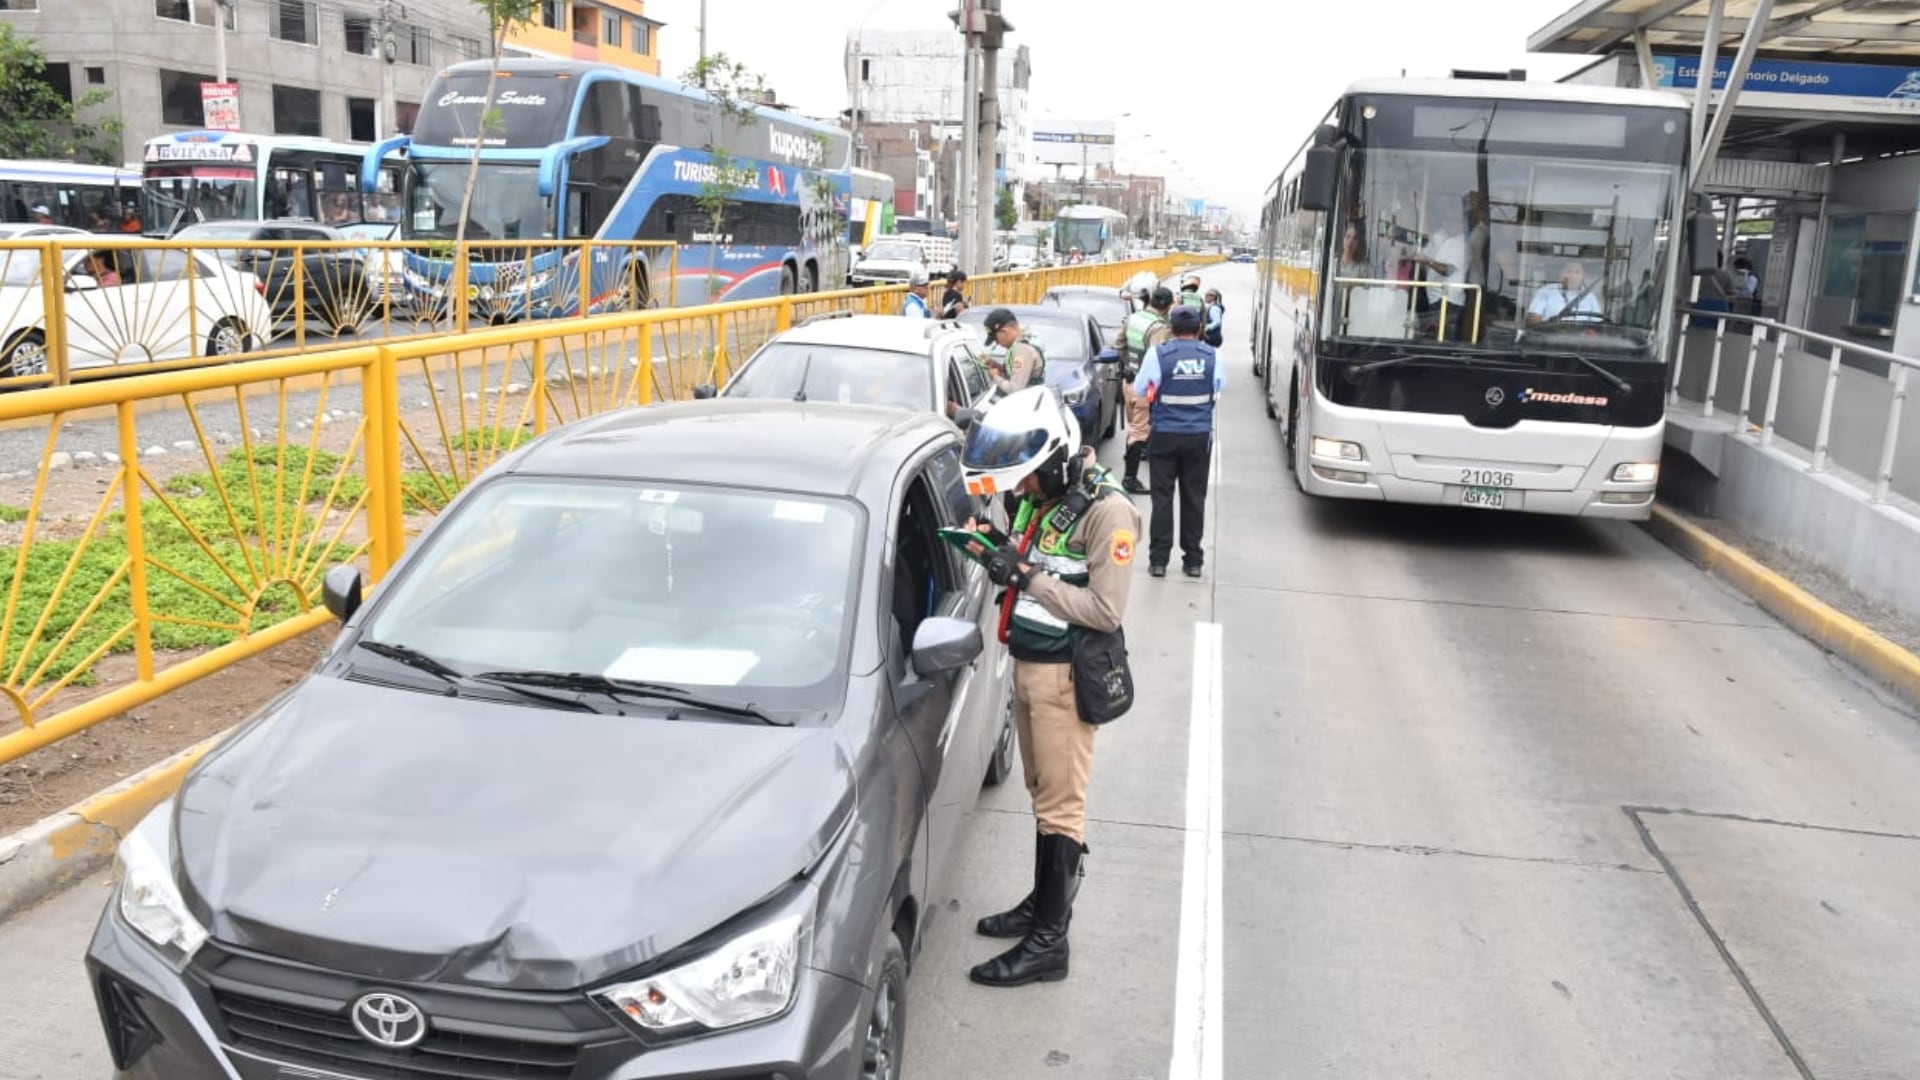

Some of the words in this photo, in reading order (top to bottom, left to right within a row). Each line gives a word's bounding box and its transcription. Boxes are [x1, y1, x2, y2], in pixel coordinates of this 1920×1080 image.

[1678, 67, 1727, 79] Estaón
[1746, 72, 1777, 82] norio
[1780, 72, 1829, 84] Delgado
[438, 91, 487, 106] Cama
[496, 91, 547, 106] Suite
[1172, 359, 1206, 374] ATU
[1530, 391, 1608, 406] modasa
[1461, 469, 1514, 486] 21036
